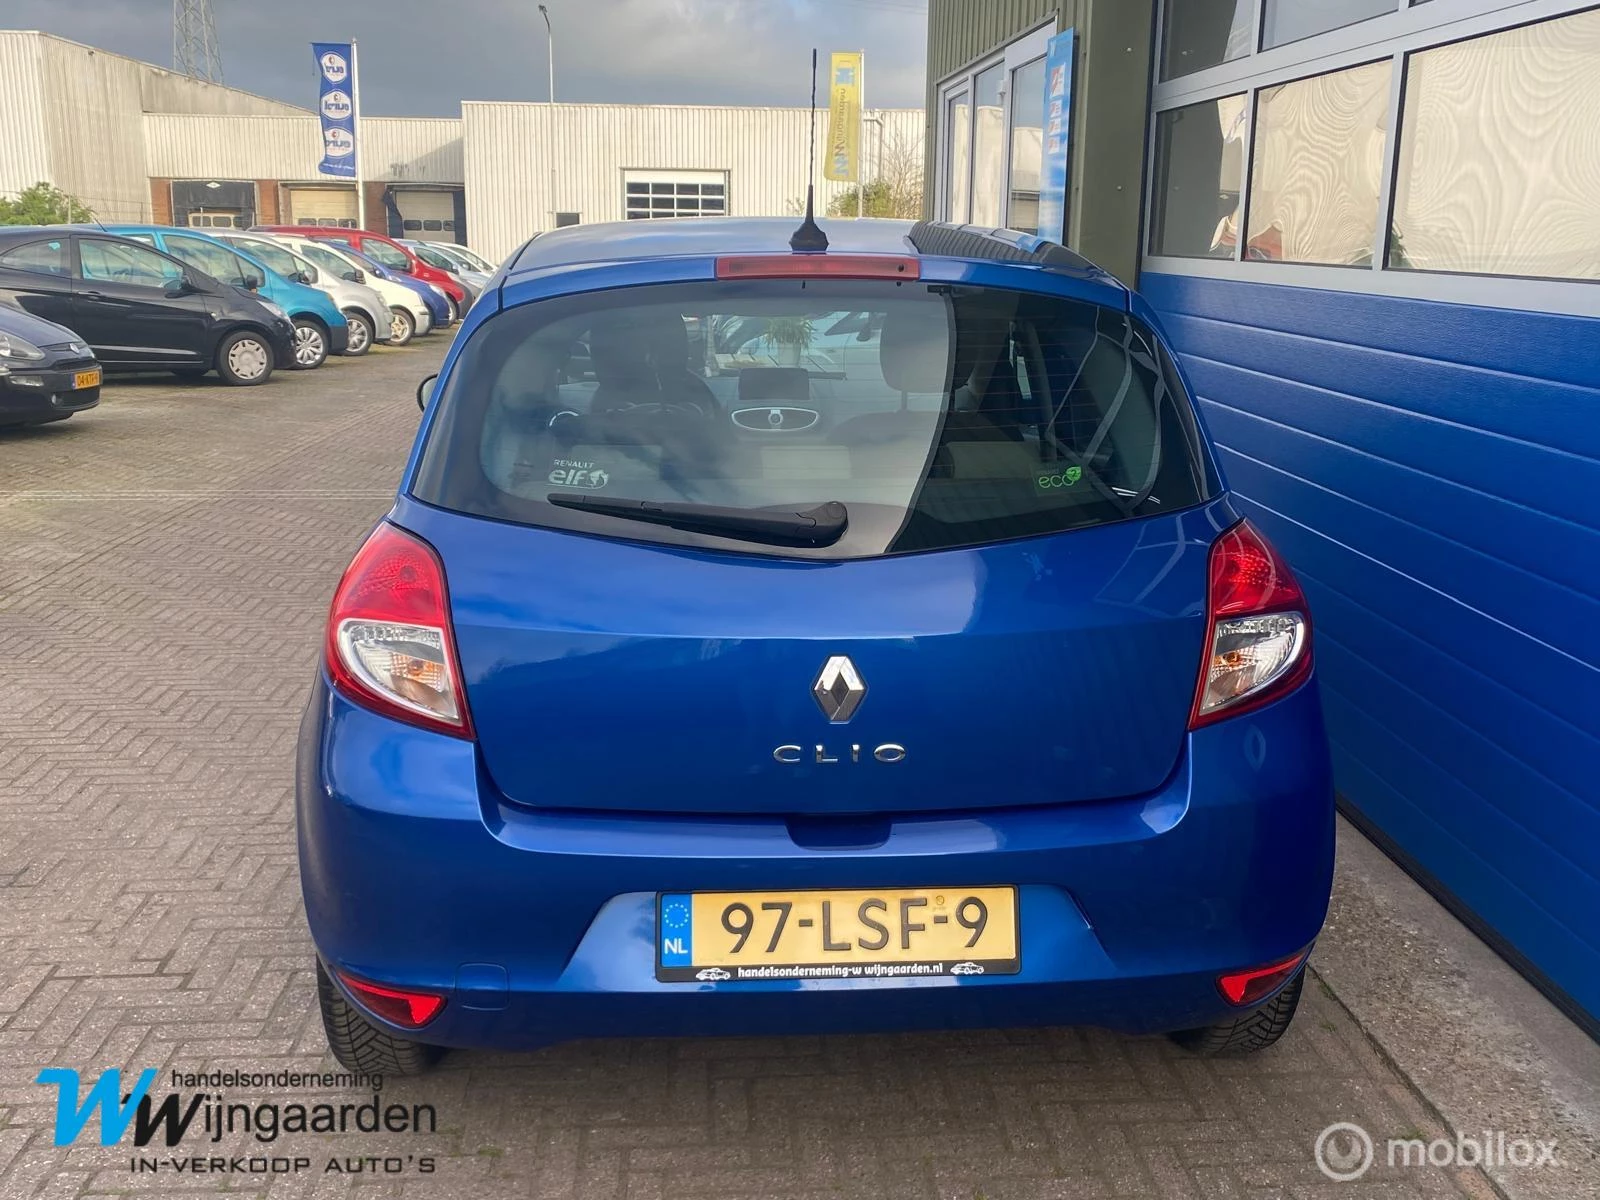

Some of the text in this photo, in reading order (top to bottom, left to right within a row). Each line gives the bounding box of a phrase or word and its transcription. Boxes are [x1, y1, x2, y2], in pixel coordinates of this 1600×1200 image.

[553, 459, 595, 469] RENAULT
[773, 743, 906, 764] CLIO
[720, 896, 989, 954] 97-LSF-9
[664, 937, 689, 955] NL
[737, 962, 943, 978] handelsonderneming-w wijngaarden.nl
